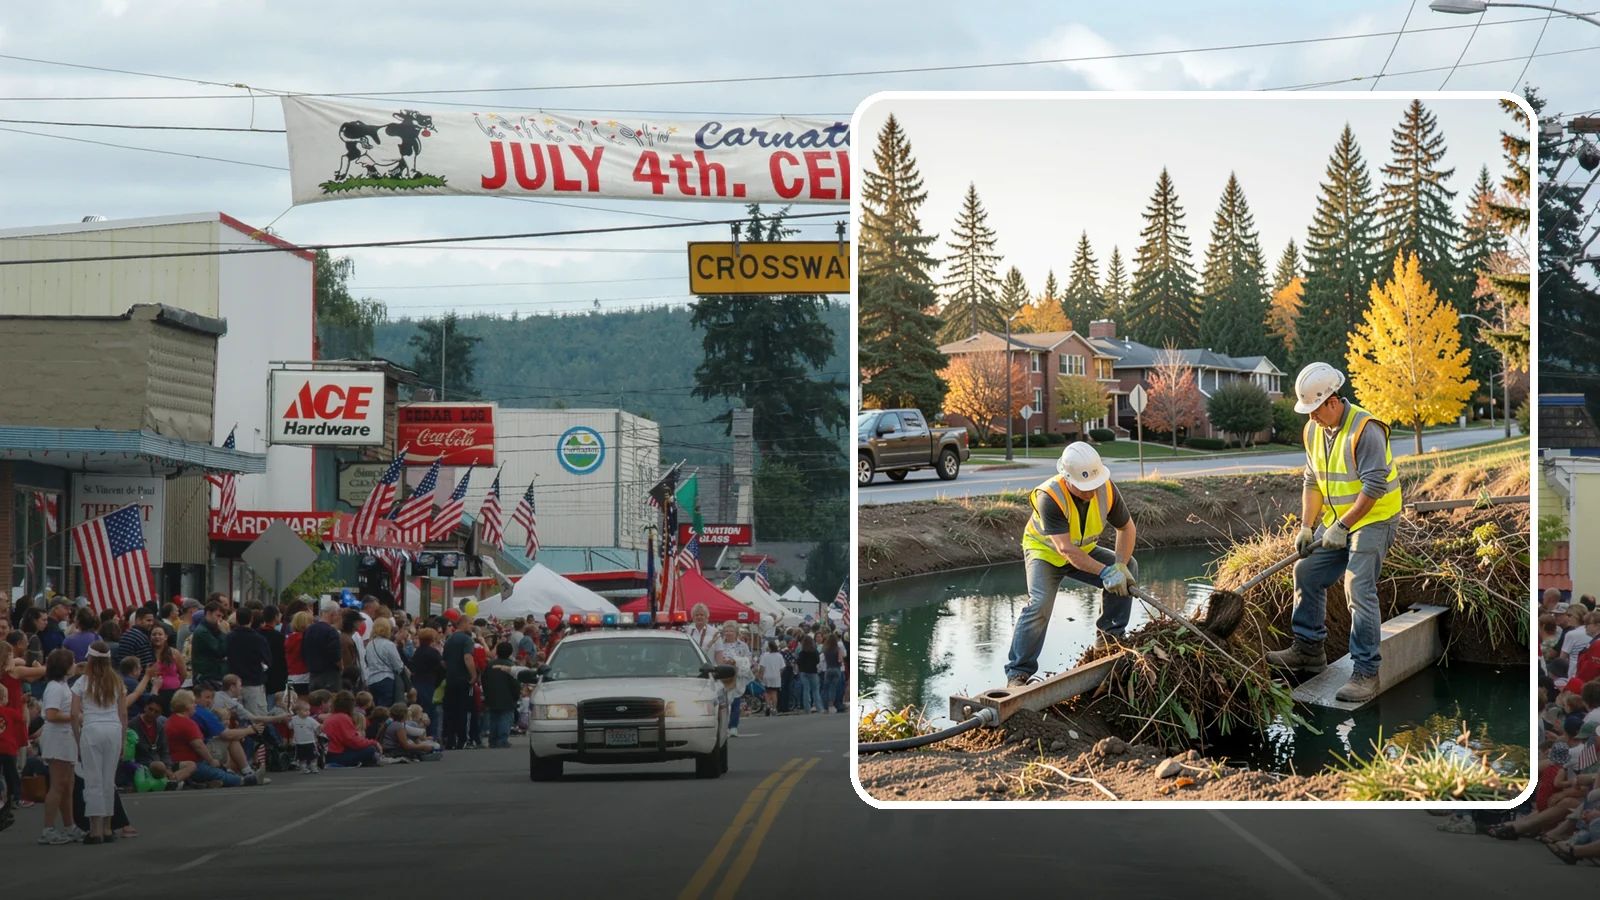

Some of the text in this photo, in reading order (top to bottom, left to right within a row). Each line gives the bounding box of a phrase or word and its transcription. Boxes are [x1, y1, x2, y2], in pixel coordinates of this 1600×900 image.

[481, 141, 605, 192] JULY
[632, 150, 746, 197] 4th.
[697, 254, 850, 279] CROSSWA
[283, 380, 373, 420] ACE
[406, 409, 485, 422] CEDAR LOG
[283, 421, 371, 436] Hardware
[416, 428, 476, 446] Coca-Cola
[354, 467, 386, 480] Simpl
[96, 485, 124, 495] Vincent
[126, 486, 136, 495] de
[138, 486, 155, 495] Paul
[688, 526, 741, 535] CRNATION
[699, 535, 730, 543] GLASS
